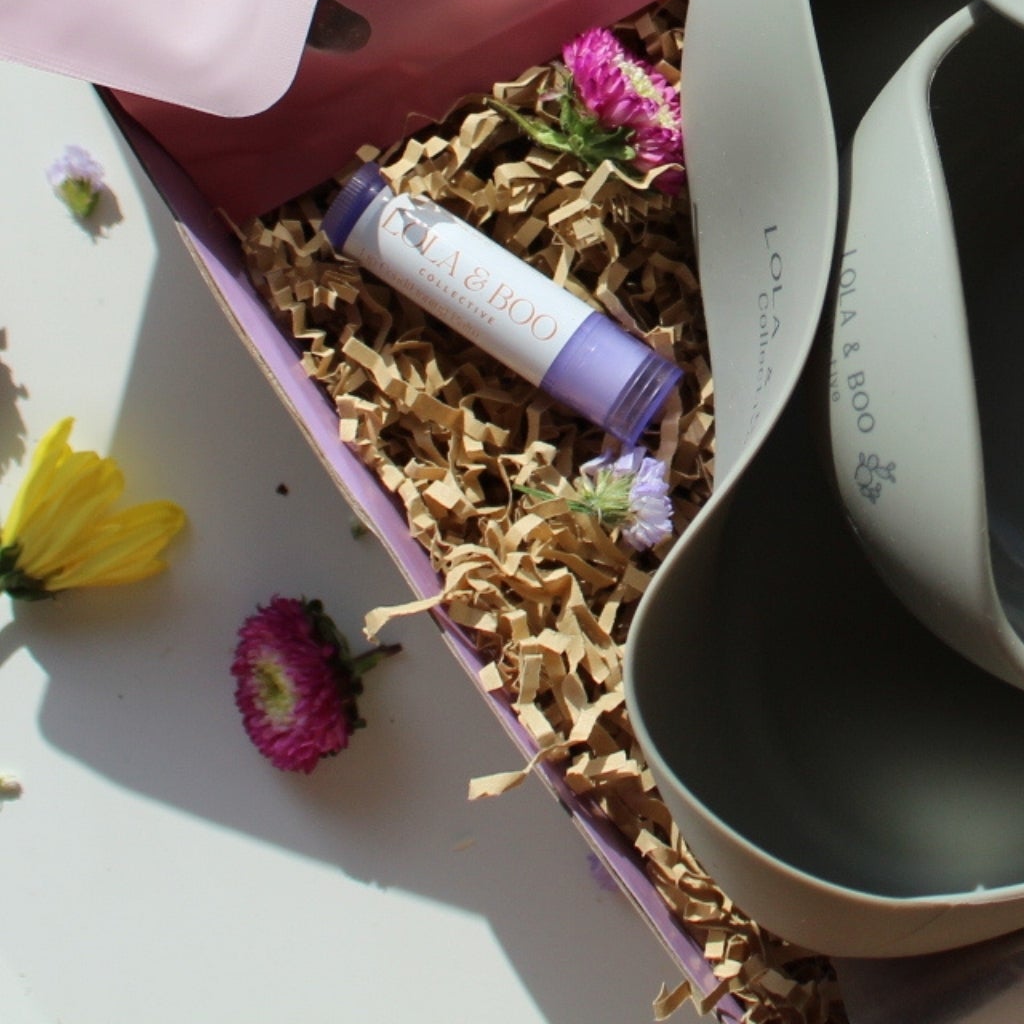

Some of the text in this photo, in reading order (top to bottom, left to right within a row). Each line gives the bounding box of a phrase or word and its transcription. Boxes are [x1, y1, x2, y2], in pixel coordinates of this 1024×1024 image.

[382, 207, 460, 278] LOLA
[463, 266, 490, 291] &
[488, 283, 558, 341] BOO
[418, 266, 496, 325] COLLECTIVE
[764, 225, 783, 338] LOLA
[842, 341, 860, 359] &
[848, 370, 875, 433] BOO
